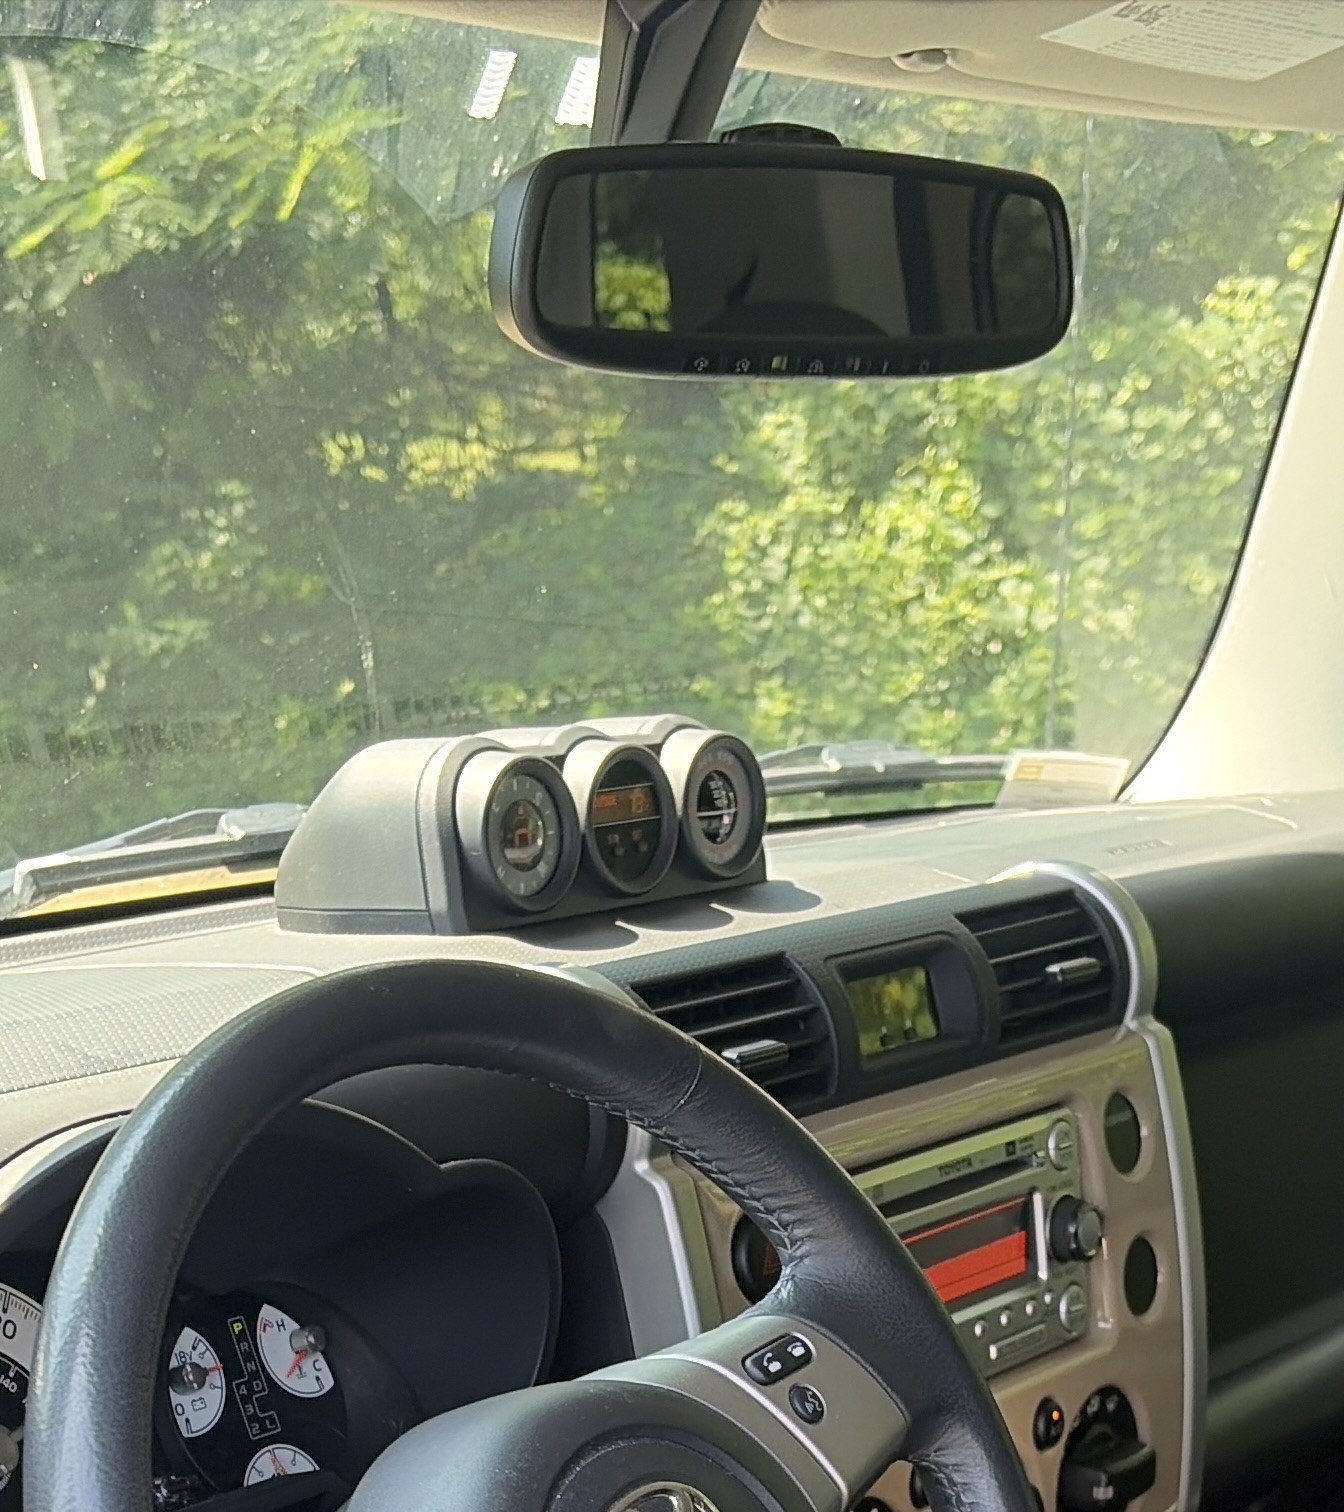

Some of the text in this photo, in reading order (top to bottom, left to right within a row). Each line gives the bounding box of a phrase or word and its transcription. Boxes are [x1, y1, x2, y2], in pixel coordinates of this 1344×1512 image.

[232, 1322, 243, 1335] P
[276, 1319, 286, 1332] H
[240, 1342, 249, 1352] R
[246, 1361, 256, 1373] N
[312, 1359, 322, 1372] C
[238, 1386, 248, 1395] 4
[253, 1381, 263, 1391] D
[265, 1419, 275, 1429] L
